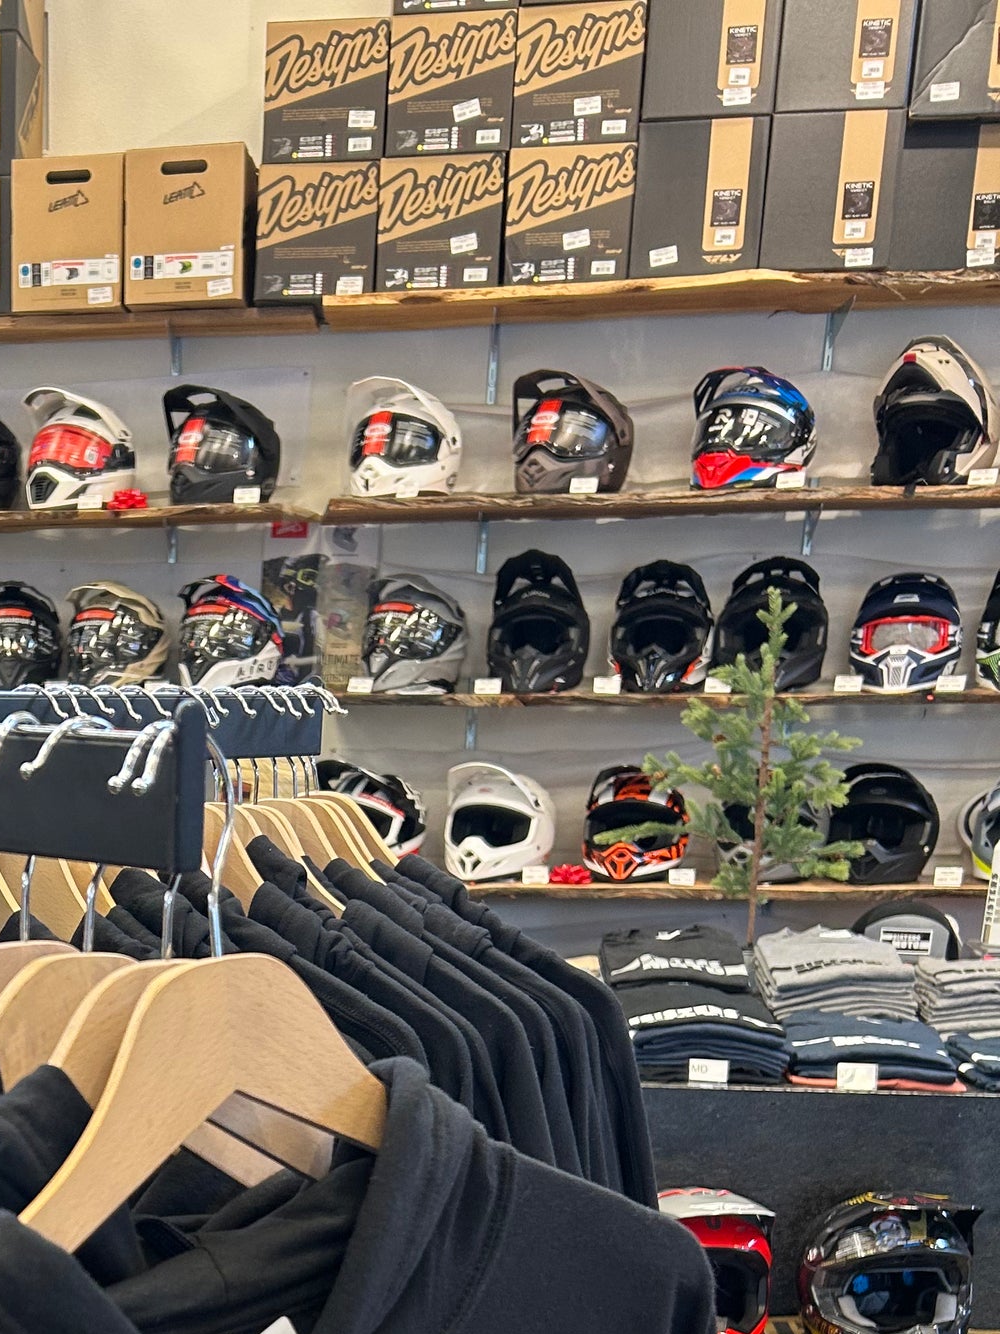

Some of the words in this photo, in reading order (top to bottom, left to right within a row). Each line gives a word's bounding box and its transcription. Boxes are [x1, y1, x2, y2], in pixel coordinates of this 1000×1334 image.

[265, 19, 391, 102] Designs
[387, 10, 517, 95] Designs
[518, 5, 647, 87] Designs
[255, 160, 381, 241] Designs
[377, 153, 505, 236] Designs
[506, 142, 637, 227] Designs
